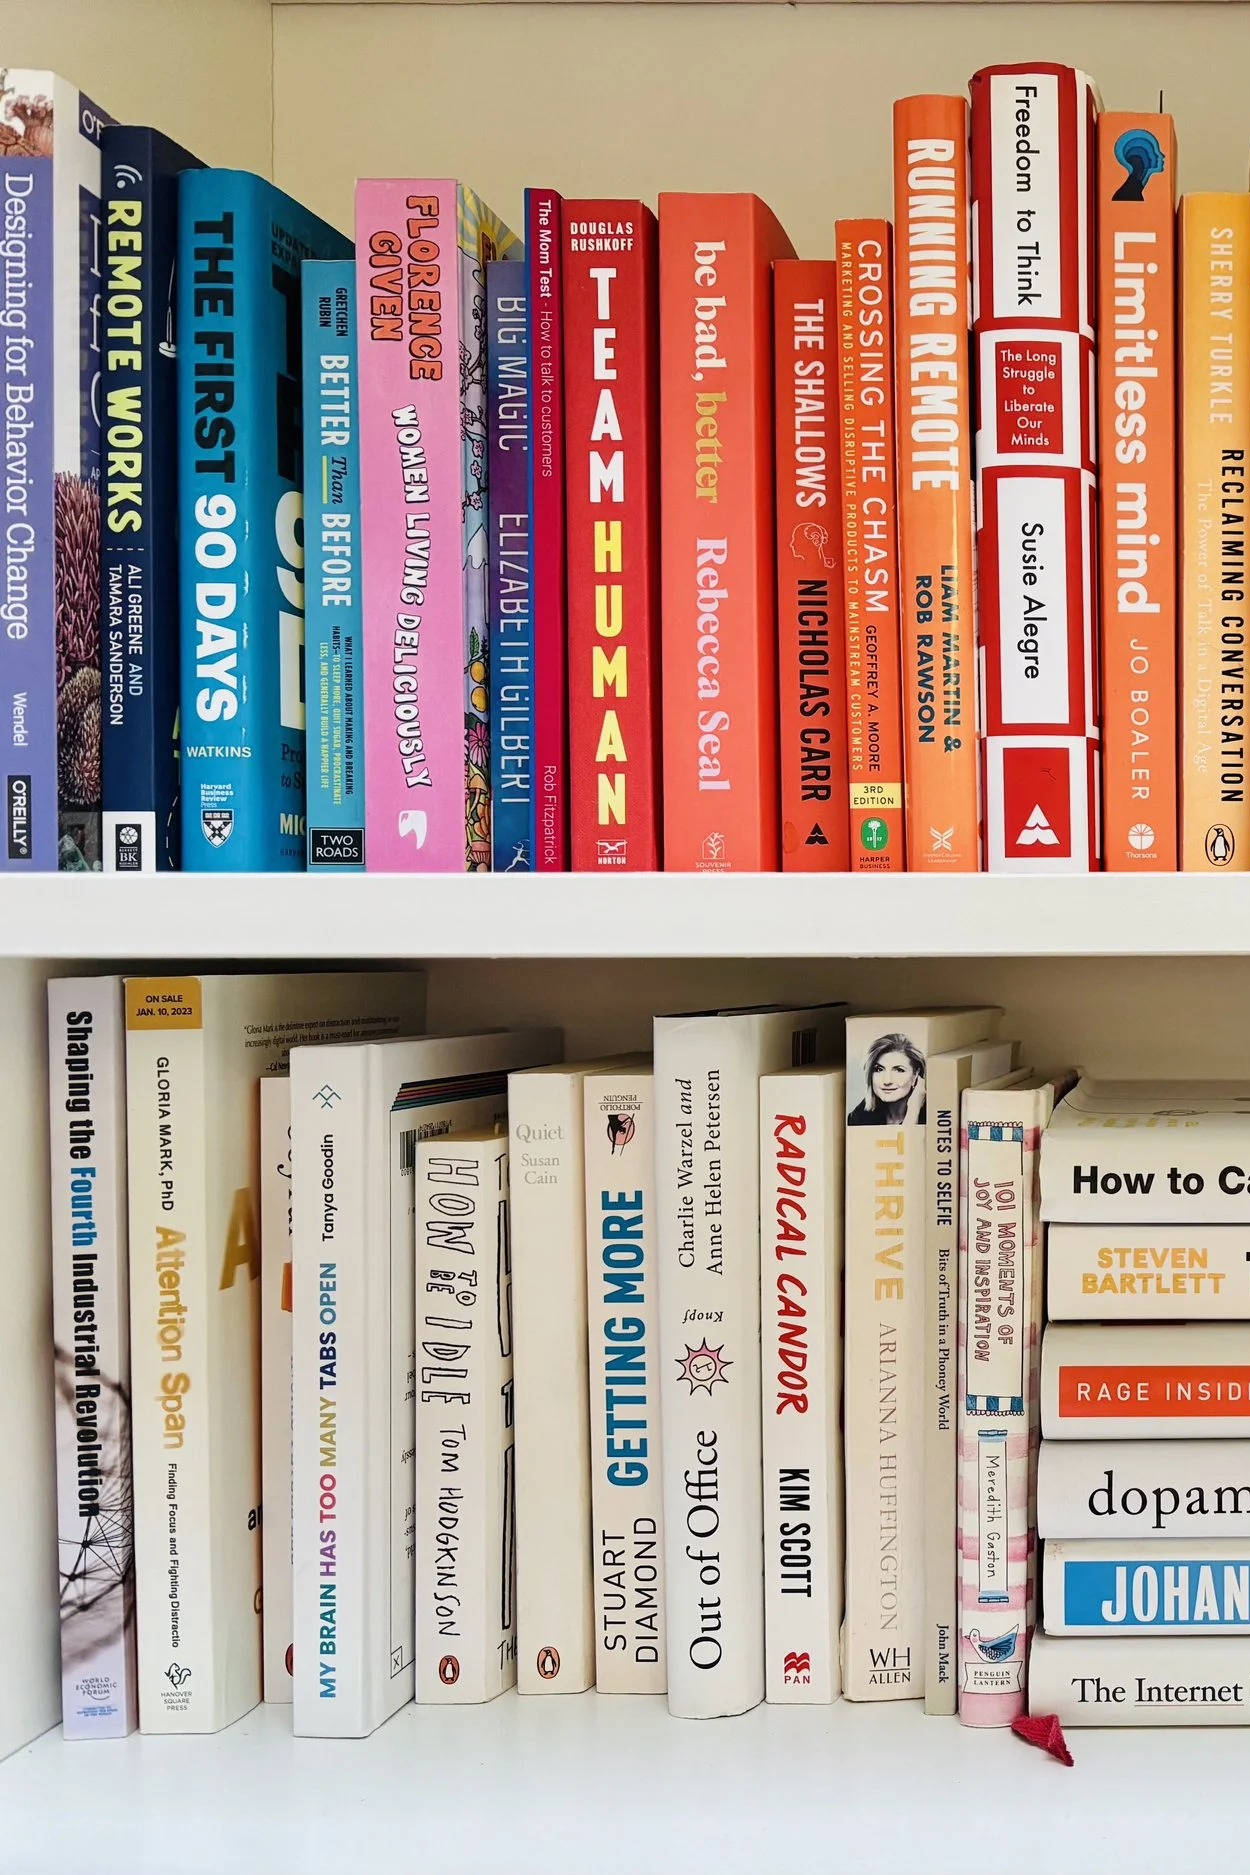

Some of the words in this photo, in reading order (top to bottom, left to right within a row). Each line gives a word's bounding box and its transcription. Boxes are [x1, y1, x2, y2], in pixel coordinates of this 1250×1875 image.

[1015, 86, 1040, 192] Freedom
[570, 222, 633, 234] DOUGLAS
[571, 239, 634, 251] RUSHKOFF
[907, 139, 957, 317] RUNNING
[1016, 209, 1036, 233] to
[0, 173, 33, 330] Designing
[194, 212, 234, 317] THE
[1016, 241, 1042, 306] Think
[107, 201, 143, 371] REMOTE
[369, 231, 403, 341] GIVEN
[406, 195, 443, 381] FLORENCE
[793, 299, 824, 350] THE
[1114, 232, 1158, 465] Limitless
[5, 335, 33, 375] for
[1000, 350, 1023, 363] The
[1026, 350, 1057, 366] Long
[1002, 367, 1055, 382] Struggle
[194, 332, 235, 483] FIRST
[320, 355, 349, 446] BETTER
[589, 268, 624, 502] TEAM
[910, 333, 959, 492] REMOTE
[1004, 400, 1055, 413] Liberate
[1022, 384, 1035, 396] to
[5, 385, 33, 516] Behavior
[794, 360, 826, 507] SHALLOWS
[1011, 433, 1050, 446] Minds
[1017, 417, 1043, 430] Our
[107, 387, 142, 533] WORKS
[331, 456, 346, 504] Than
[195, 494, 237, 569] 90
[1115, 482, 1161, 613] mind
[1222, 449, 1245, 602] RECLAIMING
[0, 524, 34, 639] Change
[322, 513, 351, 606] BEFORE
[1021, 523, 1044, 587] Susie
[195, 584, 238, 722] DAYS
[797, 580, 830, 717] NICHOLAS
[1017, 595, 1047, 679] Alegre
[592, 521, 628, 825] HUMAN
[13, 692, 28, 746] Wendel
[1221, 616, 1244, 802] CONVERSATION
[186, 747, 252, 758] WATKINS
[544, 765, 557, 791] Rob
[800, 730, 831, 801] CARR
[854, 797, 894, 805] EDITION
[863, 786, 884, 794] 3RD
[316, 846, 358, 858] ROADS
[320, 835, 353, 845] TWO
[542, 795, 557, 864] Fitzpatrick
[136, 1008, 155, 1016] JAN.
[158, 1008, 170, 1016] 10,
[172, 1007, 192, 1016] 2023
[157, 1057, 170, 1119] GLORIA
[159, 1125, 173, 1176] MARK,
[516, 1124, 564, 1143] Quiet
[937, 1110, 952, 1153] NOTES
[321, 1134, 334, 1189] Goodin
[521, 1154, 560, 1167] Susan
[524, 1171, 558, 1184] Cain
[937, 1159, 951, 1176] TO
[1073, 1166, 1155, 1194] How
[1167, 1168, 1204, 1194] to
[161, 1180, 173, 1211] PhD
[322, 1193, 338, 1241] Tanya
[937, 1182, 952, 1225] SELFIE
[602, 1190, 645, 1304] MORE
[1097, 1248, 1208, 1268] STEVEN
[1082, 1273, 1225, 1294] BARTLETT
[604, 1317, 648, 1486] GETTING
[684, 1430, 719, 1538] Office
[779, 1468, 810, 1512] KIM
[686, 1546, 720, 1585] of
[780, 1523, 811, 1598] SCOTT
[602, 1529, 626, 1650] STUART
[634, 1517, 658, 1663] DIAMOND
[689, 1597, 722, 1669] Out
[870, 1648, 911, 1667] WH
[784, 1676, 810, 1684] PAN
[869, 1672, 911, 1684] ALLEN
